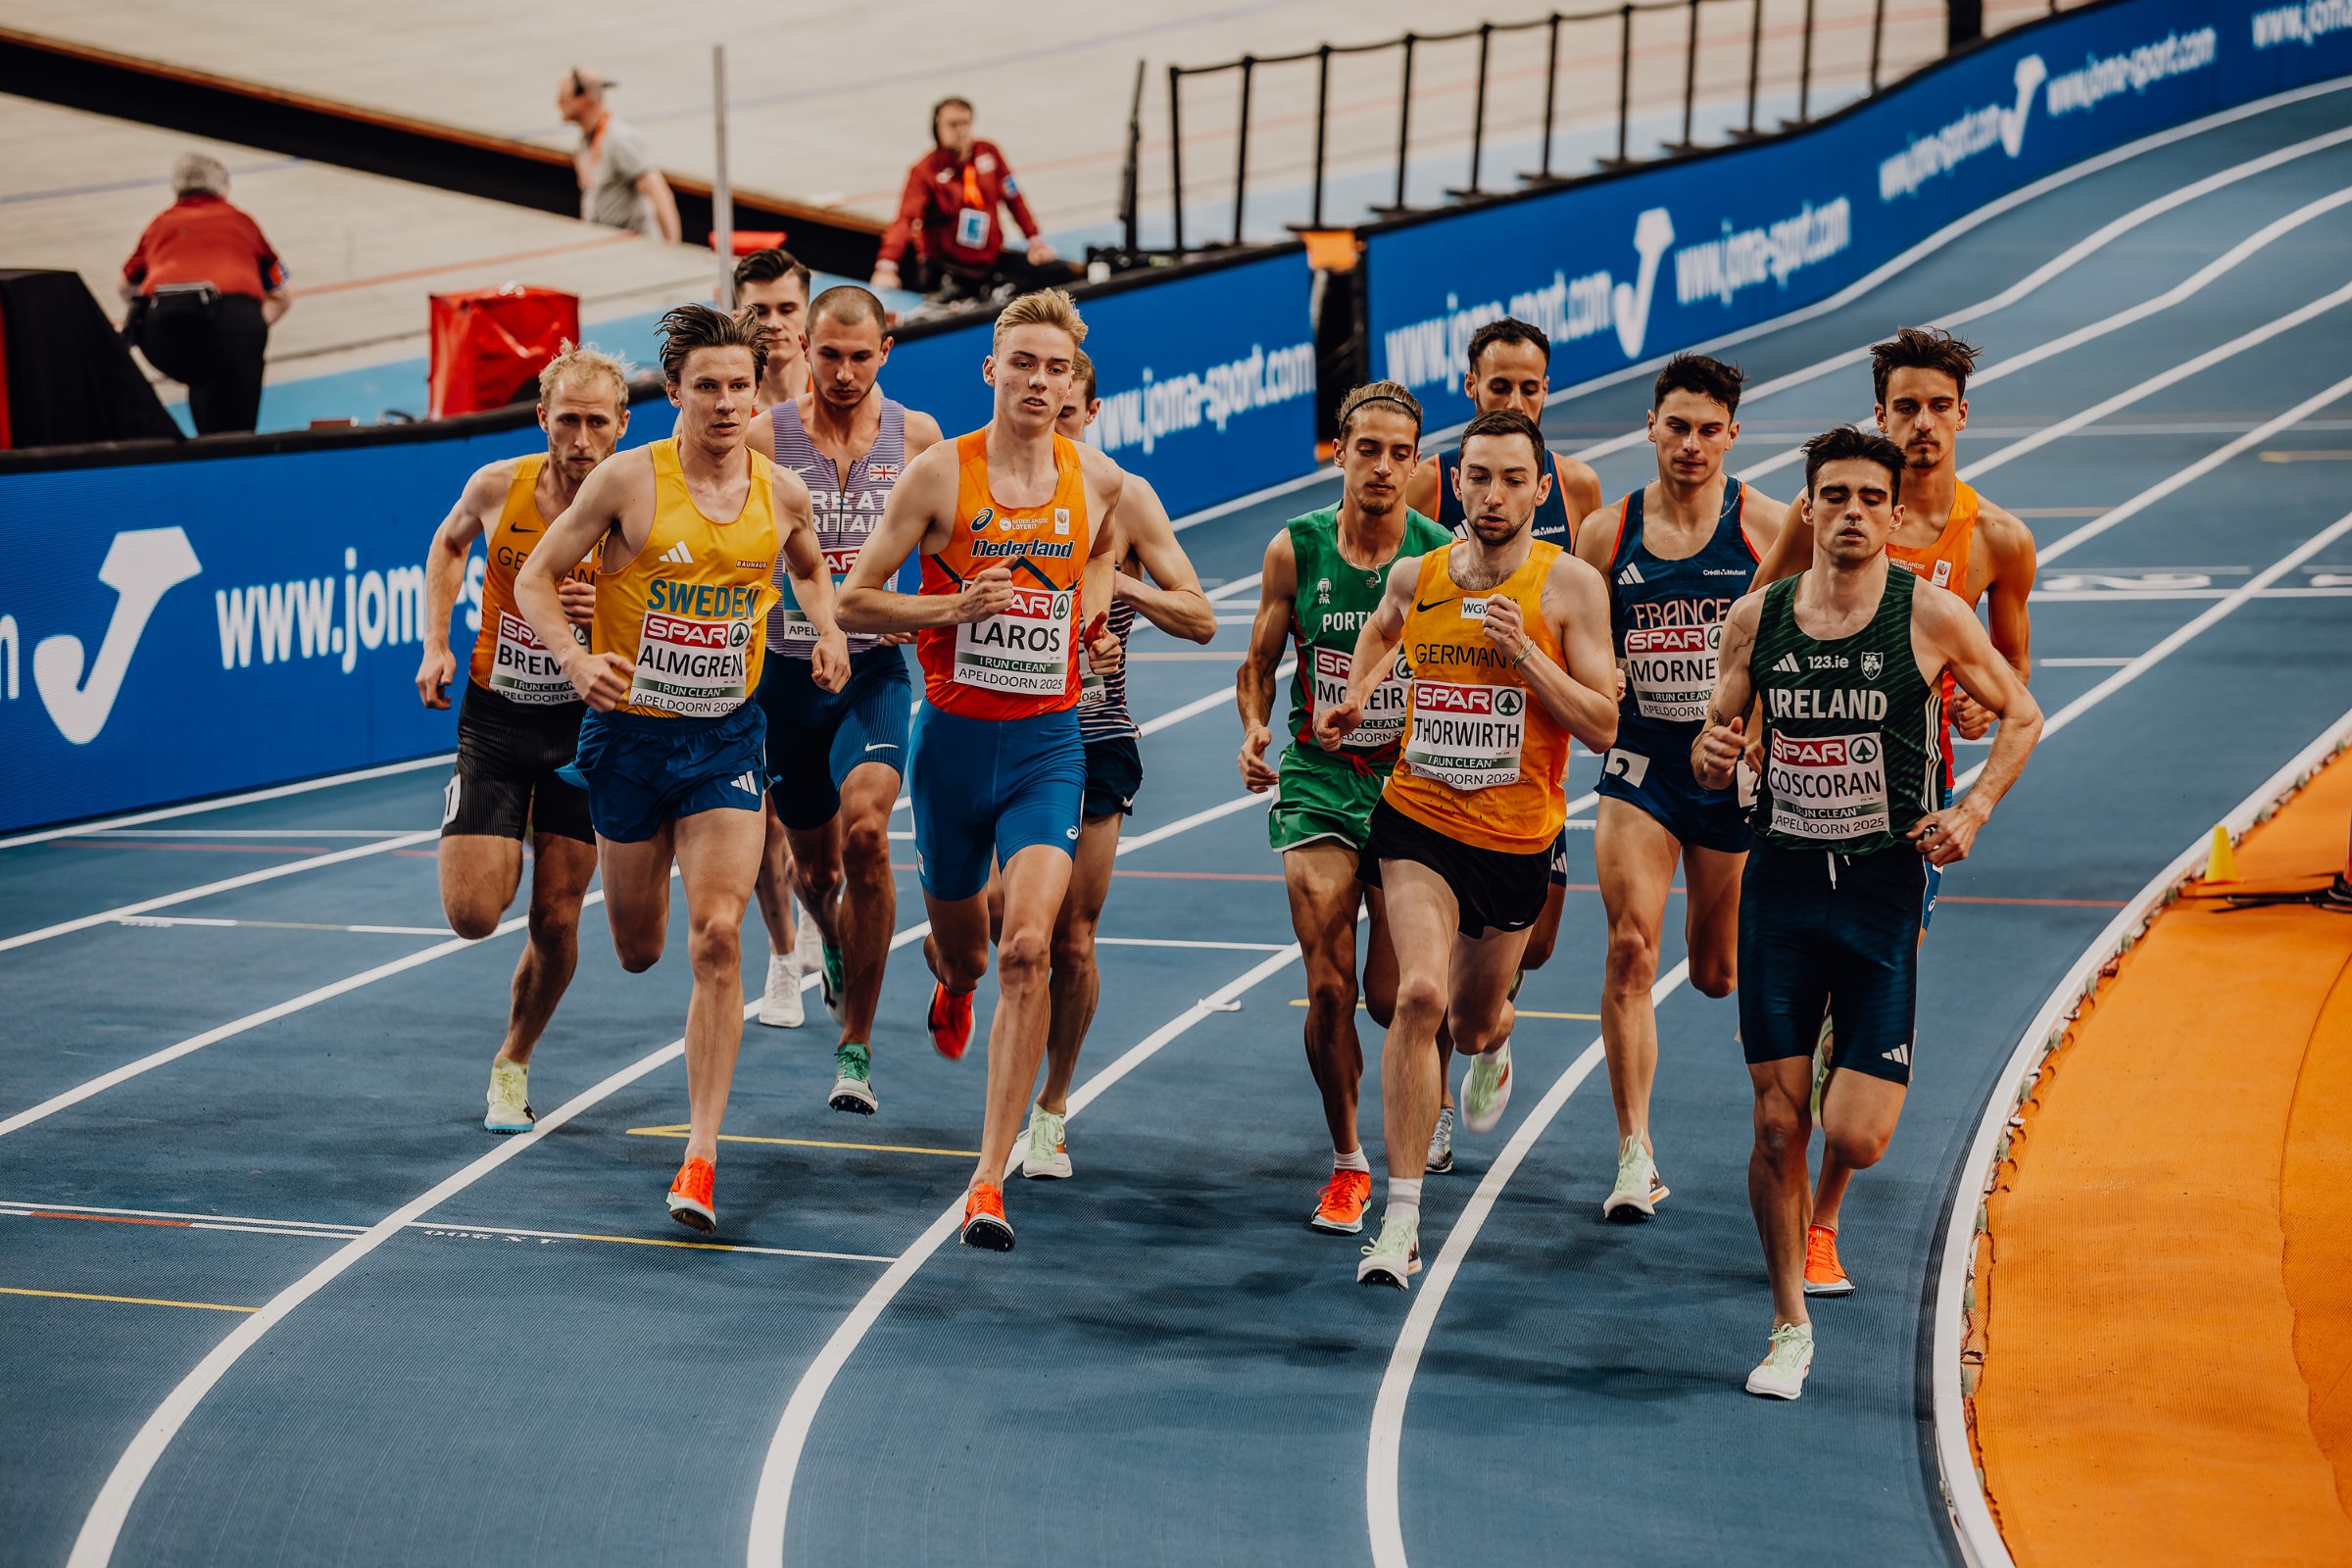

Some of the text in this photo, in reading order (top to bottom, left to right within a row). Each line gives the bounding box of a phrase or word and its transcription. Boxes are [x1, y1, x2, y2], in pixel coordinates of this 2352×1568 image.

[808, 489, 892, 510] REAT
[813, 513, 884, 533] RITAI
[970, 538, 1075, 559] Nederland
[647, 579, 760, 618] SWEDEN
[1004, 593, 1051, 616] AR
[1322, 611, 1372, 633] PORT
[1632, 599, 1732, 629] FRANCE
[647, 618, 727, 646] SPAR
[970, 622, 1060, 653] LAROS
[1629, 630, 1703, 650] SPAR
[498, 643, 563, 676] BREM
[637, 645, 745, 679] ALMGREN
[985, 658, 1009, 669] RUN
[1414, 643, 1517, 669] GERMAN
[1807, 655, 1850, 669] 123.ie
[958, 667, 1063, 690] APELDOORN 2025
[1631, 657, 1719, 683] MORNE
[519, 681, 541, 691] RUN
[663, 683, 687, 695] RUN
[1081, 690, 1102, 702] 025
[1677, 691, 1710, 702] CLEAN
[634, 694, 711, 712] APELDOORN
[1417, 687, 1491, 710] SPAR
[1768, 688, 1888, 721] IRELAND
[1643, 705, 1704, 717] APELDOORN
[1347, 732, 1392, 743] DOORN
[1414, 716, 1520, 749] THORWIRTH
[1773, 737, 1845, 763] SPAR
[1433, 757, 1453, 767] RUN
[1486, 772, 1516, 785] 2025
[1769, 766, 1882, 799] COSCORAN
[1796, 806, 1817, 818] RUN
[1775, 814, 1885, 834] APELDOORN 2025
